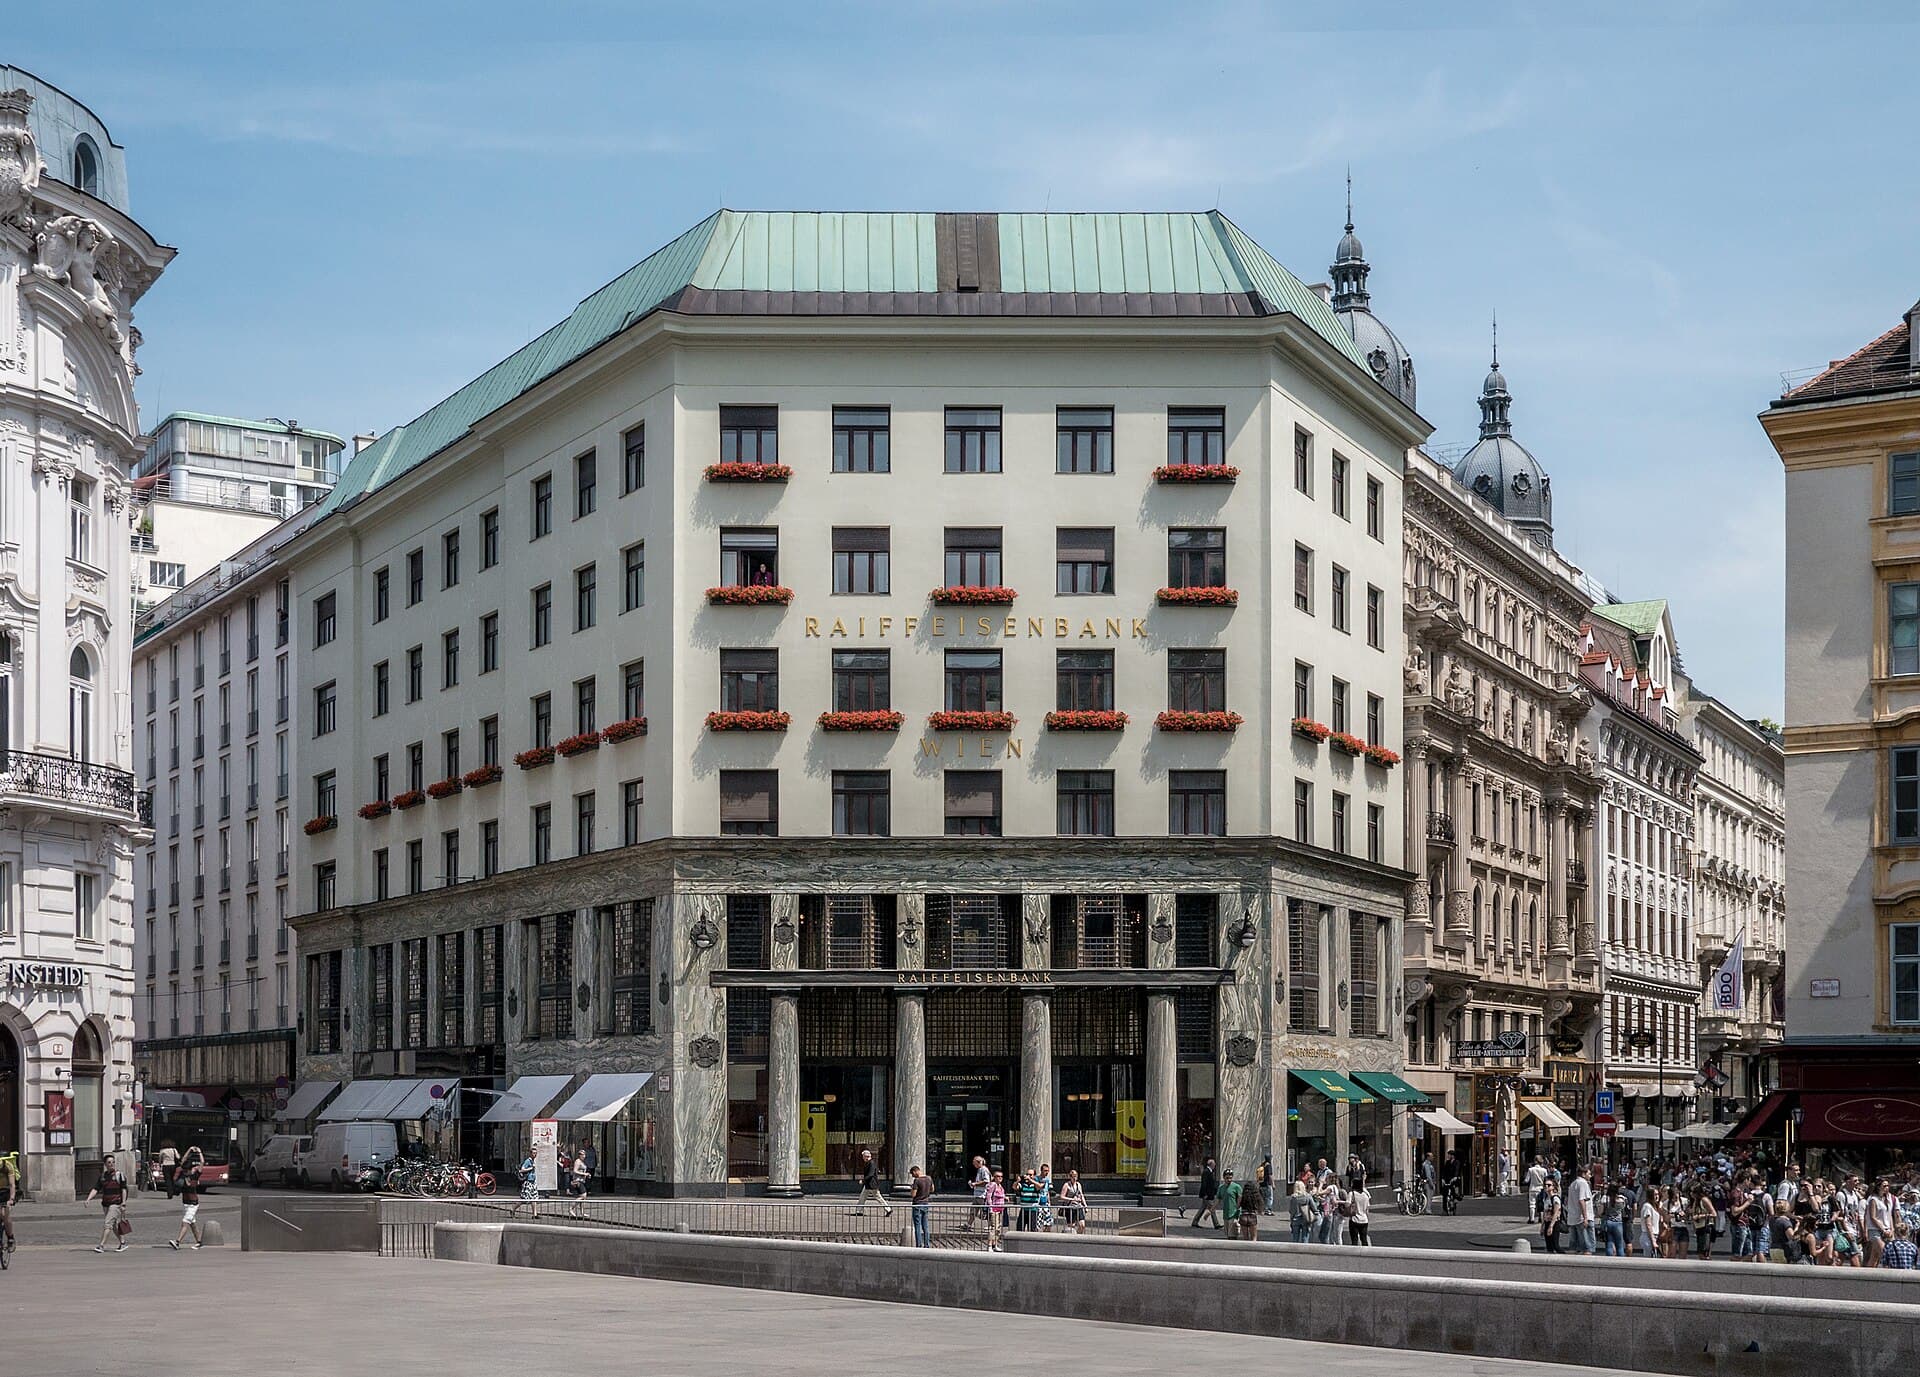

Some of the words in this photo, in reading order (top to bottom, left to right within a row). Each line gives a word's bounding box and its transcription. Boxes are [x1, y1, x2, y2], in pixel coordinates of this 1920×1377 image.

[804, 616, 1148, 638] RAIFFEISENBANK
[919, 738, 1023, 758] WIEN
[898, 972, 1051, 983] RAIFFEISENBANK
[1720, 972, 1733, 1004] BDO
